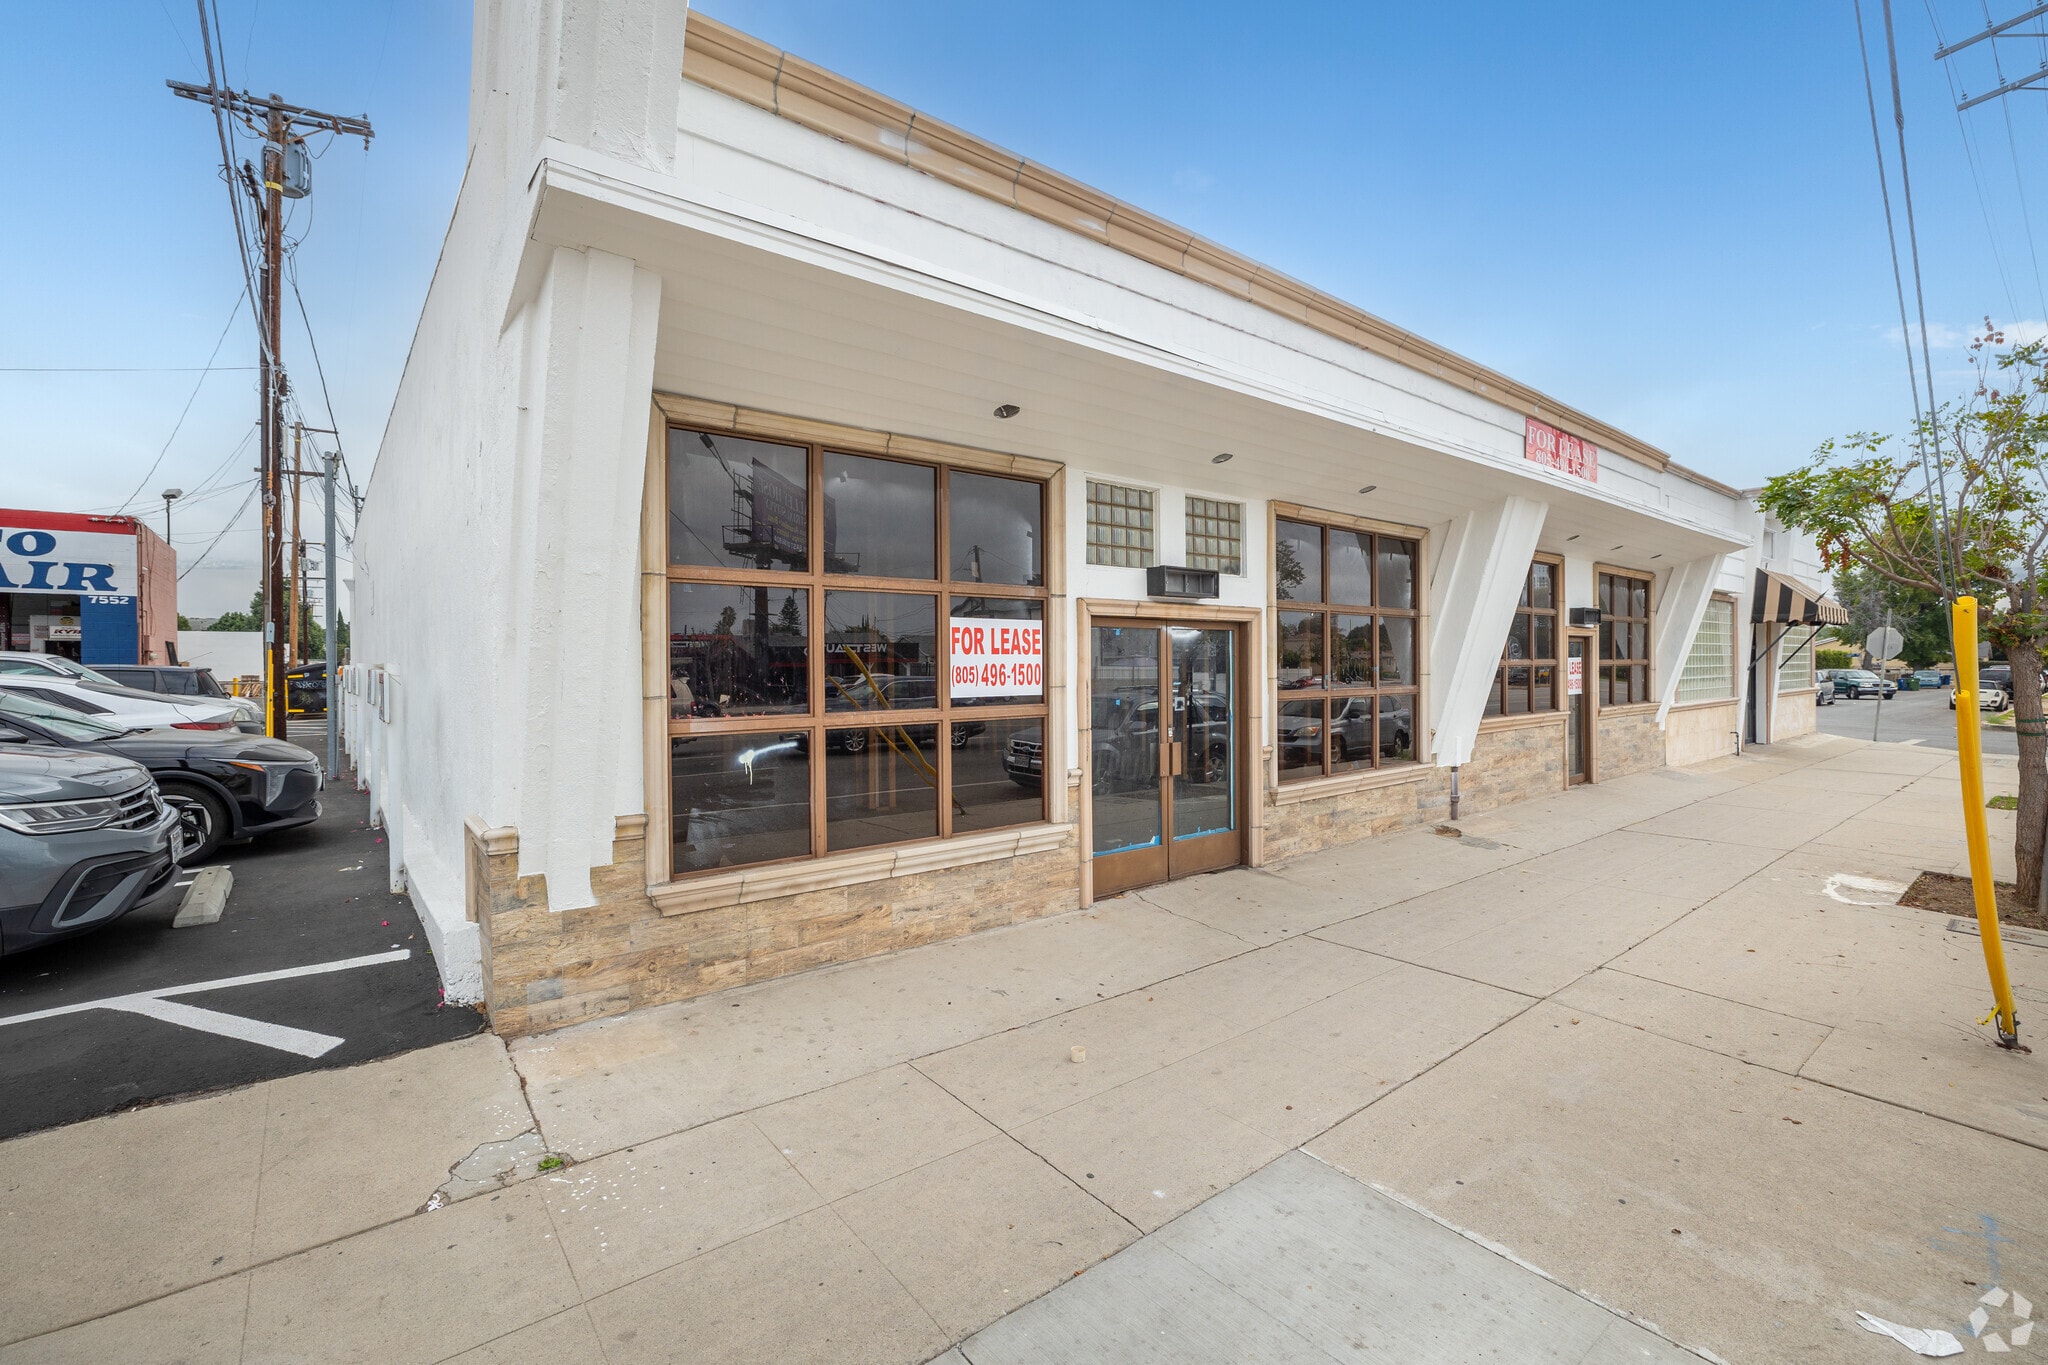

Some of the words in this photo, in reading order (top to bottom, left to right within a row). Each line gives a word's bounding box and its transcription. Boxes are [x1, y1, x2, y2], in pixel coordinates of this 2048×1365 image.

[1528, 426, 1556, 453] FOR
[1559, 437, 1596, 467] LEASE
[0, 529, 57, 557] O
[88, 595, 129, 605] 7552
[951, 626, 985, 655] FOR
[990, 627, 1041, 655] LEASE
[951, 664, 979, 687] (805)
[981, 663, 1041, 687] 496-1500
